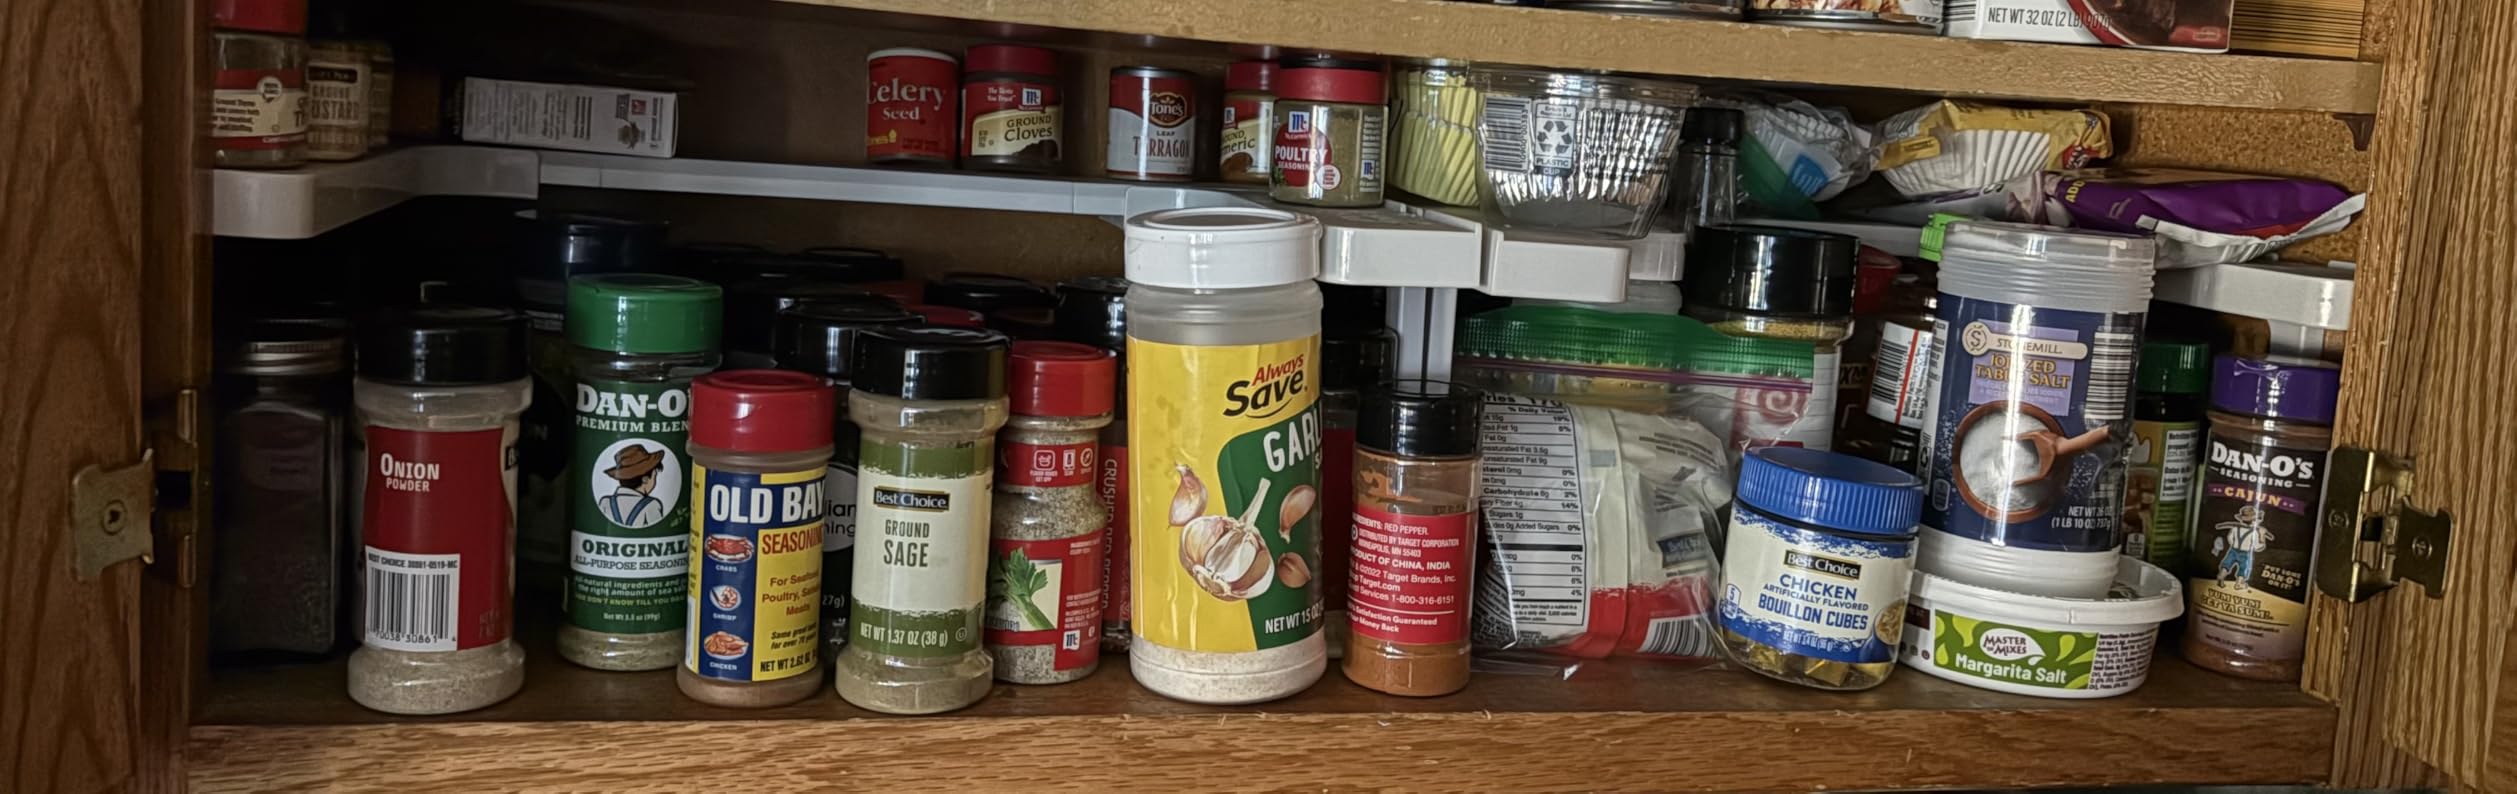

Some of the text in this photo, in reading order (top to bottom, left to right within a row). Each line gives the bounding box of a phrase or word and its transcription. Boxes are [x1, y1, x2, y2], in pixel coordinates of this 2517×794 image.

[1988, 7, 2008, 23] NET
[2010, 8, 2025, 24] WT
[2026, 9, 2039, 25] 32
[2041, 10, 2055, 26] OZ
[312, 100, 360, 119] USTARD
[881, 106, 920, 120] Seed
[1006, 115, 1053, 128] GROUND
[1004, 127, 1053, 141] Cloves
[1224, 130, 1245, 143] OUND
[1133, 135, 1190, 158] TRRAGO
[1222, 137, 1256, 154] meric
[1275, 145, 1328, 164] POULTRY
[1536, 158, 1569, 167] PLASTIC
[1278, 162, 1317, 171] SEASONIN
[1251, 353, 1304, 386] Always
[2030, 373, 2071, 388] SALT
[576, 415, 689, 432] PREMIUM BLEN
[1263, 407, 1322, 473] GARL
[2211, 441, 2315, 480] DAN-O'S
[386, 477, 430, 492] POWDER
[2220, 467, 2293, 488] SEASONING
[876, 491, 947, 508] Best Choice
[1484, 488, 1538, 496] Carbohydrate
[2224, 486, 2282, 507] CAJUN
[709, 484, 774, 524] OLD
[782, 479, 826, 523] BAY
[2068, 505, 2084, 517] NET
[885, 519, 930, 538] GROUND
[1384, 522, 1399, 533] RED
[1538, 523, 1560, 531] Sugars
[2051, 516, 2060, 529] (1
[2061, 517, 2072, 528] LB
[2074, 518, 2084, 529] 10
[582, 539, 688, 558] ORIGINAL
[762, 526, 824, 555] SEASONIN
[1398, 537, 1421, 547] TARGET
[1421, 538, 1459, 548] CORPORATION
[884, 540, 929, 567] SAGE
[575, 555, 688, 571] ALL-PURPOSE SEASONIN
[1378, 556, 1390, 566] OF
[1392, 558, 1425, 571] CHINA,
[1427, 561, 1451, 570] INDIA
[1787, 553, 1859, 577] Best Choice
[613, 579, 661, 590] ingredients
[770, 577, 788, 587] For
[1359, 575, 1401, 592] Target.com
[1383, 570, 1409, 583] Target
[1410, 574, 1442, 584] Brands,
[1444, 575, 1456, 583] Inc.
[611, 588, 645, 596] amount
[1780, 574, 1858, 601] CHICKEN
[762, 592, 800, 604] Poultry,
[1764, 584, 1869, 612] ARTIFICIALLY FLAVORED
[2208, 588, 2261, 609] YUM YUM
[1758, 593, 1822, 625] BOUILLON
[1826, 611, 1869, 631] CUBES
[2220, 602, 2236, 613] YA
[1265, 616, 1285, 634] NET
[1286, 612, 1300, 629] WT
[1301, 608, 1311, 624] 15
[1359, 615, 1400, 633] Money Back
[1393, 615, 1438, 626] Guaranteed
[861, 622, 872, 639] NET
[874, 625, 886, 643] WT
[888, 629, 905, 645] 1.37
[907, 630, 920, 646] OZ
[921, 630, 937, 649] (38
[939, 629, 949, 648] g)
[1983, 635, 2027, 648] MASTER
[1993, 645, 2027, 657] MIXES
[709, 661, 738, 671] CHICKEN
[760, 660, 776, 672] NET
[777, 658, 789, 670] WT
[1955, 653, 2067, 684] Margarita Salt
